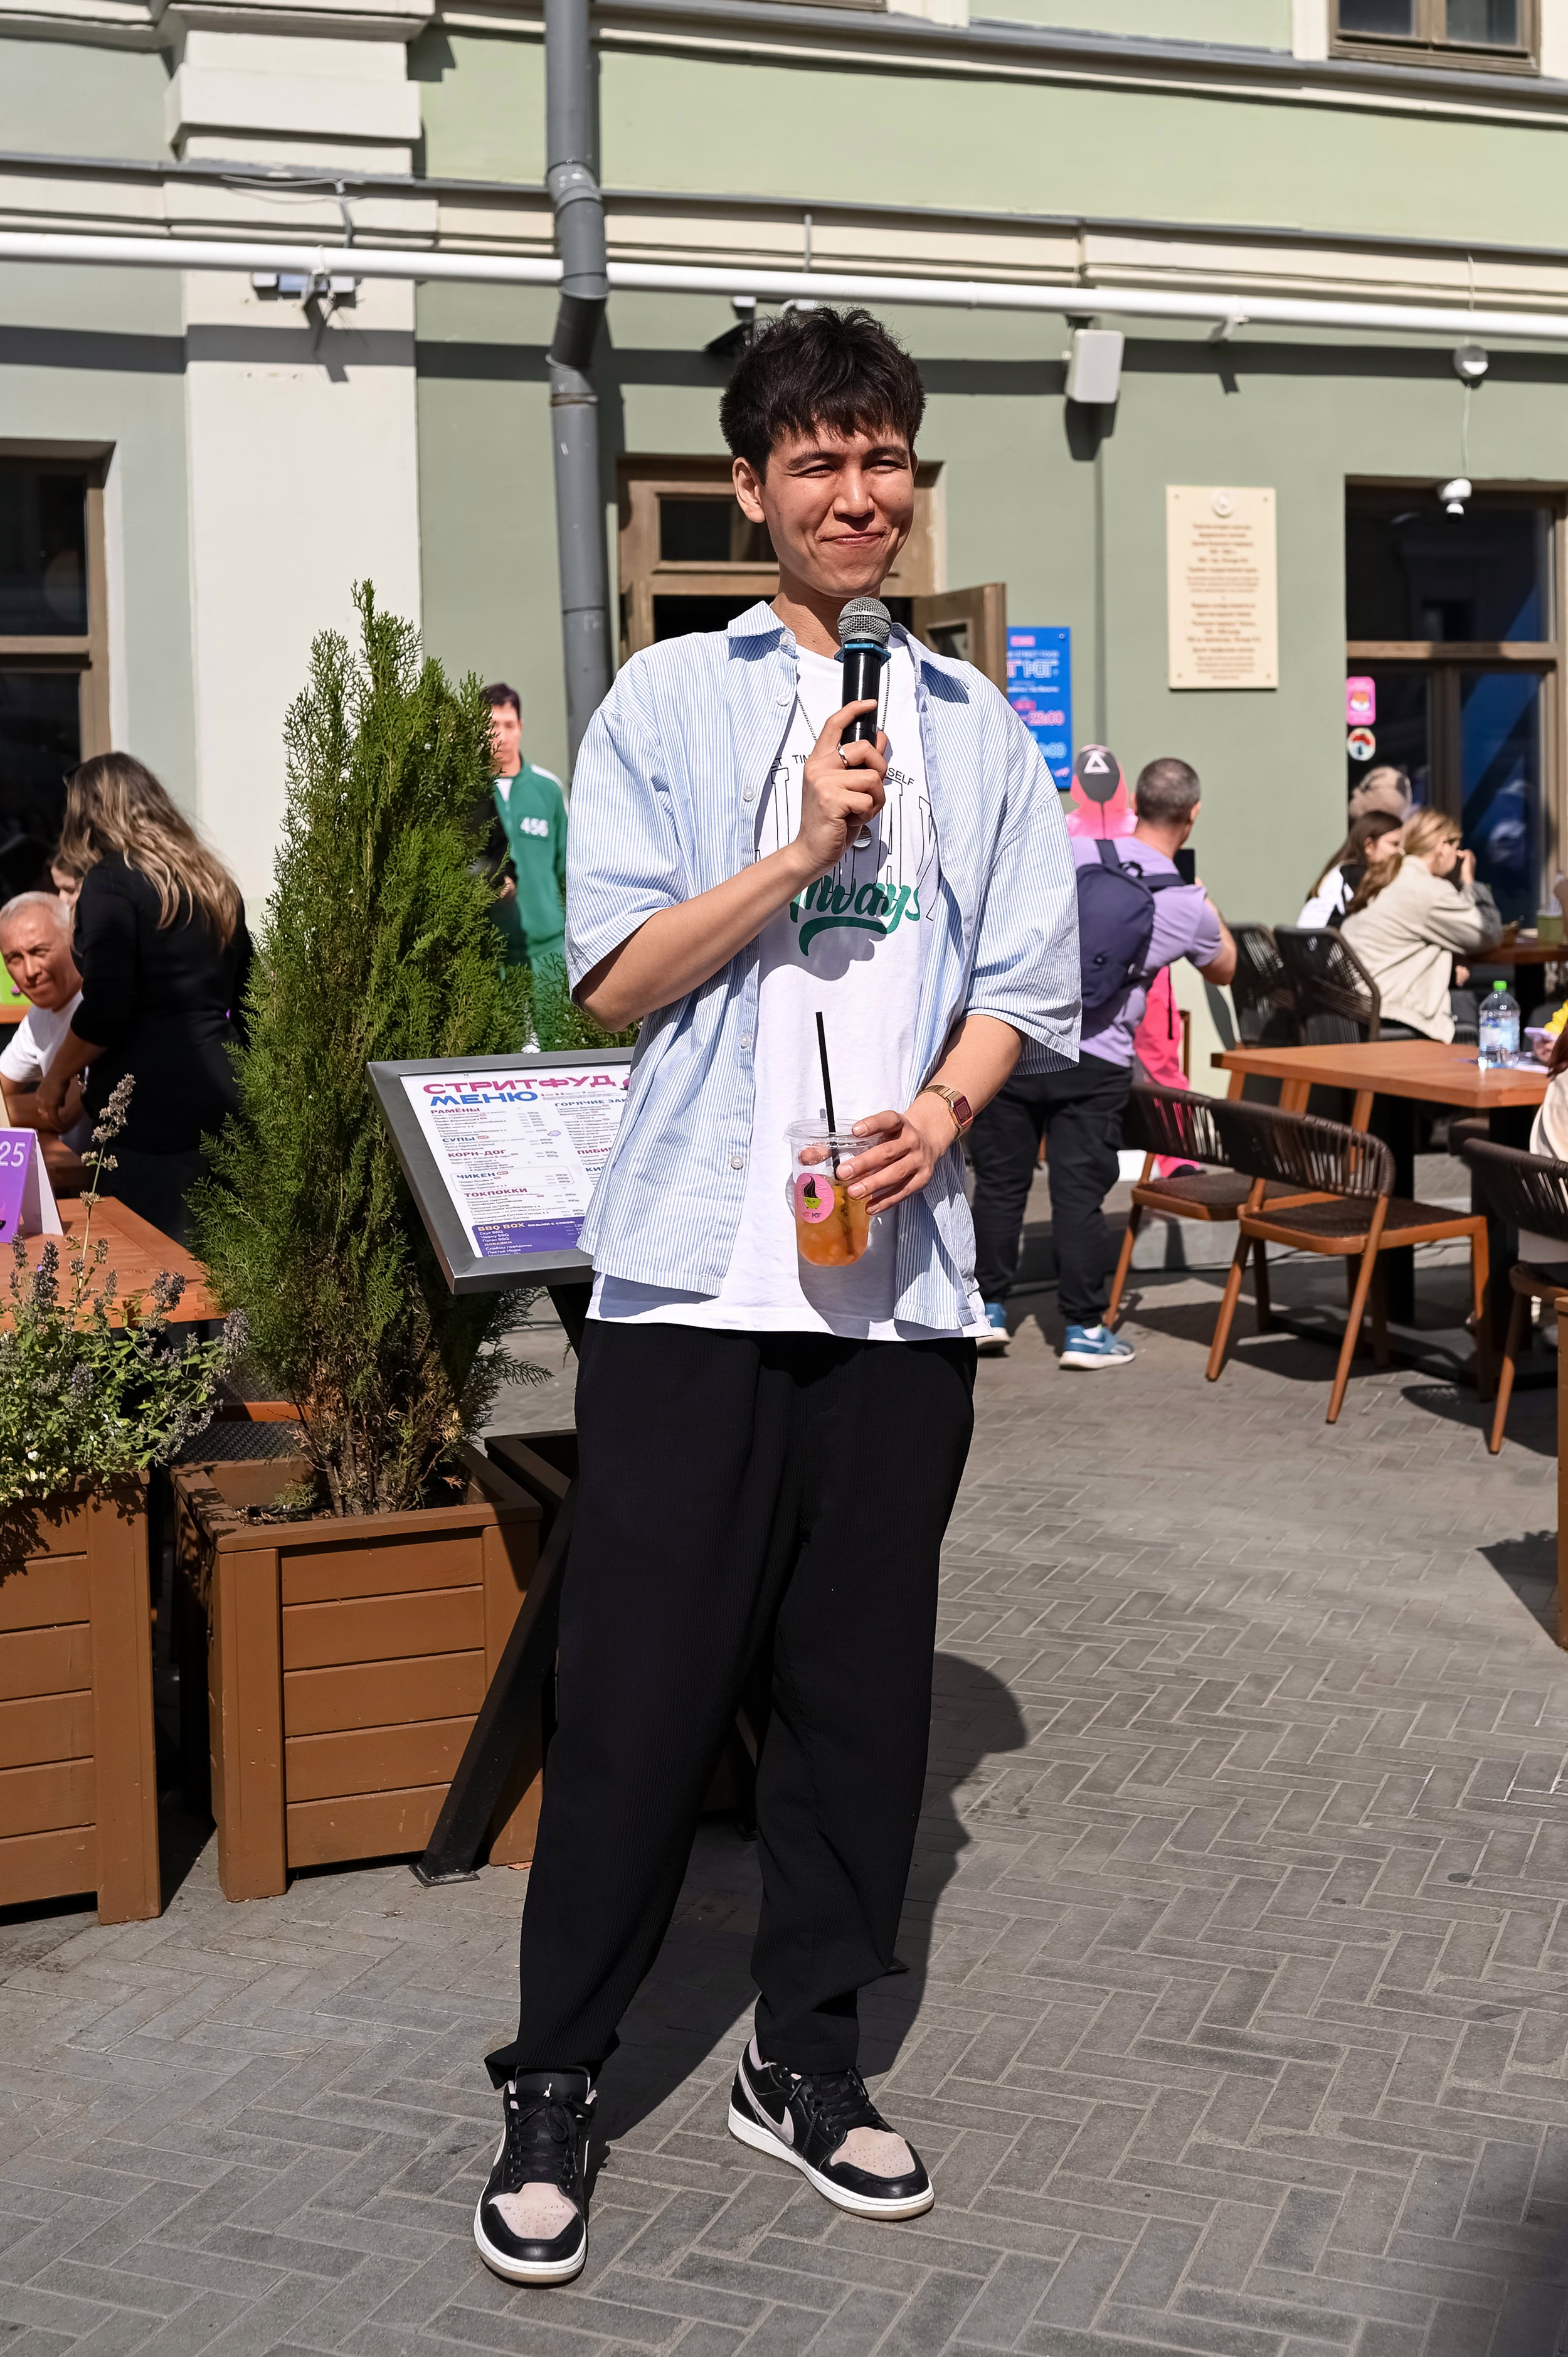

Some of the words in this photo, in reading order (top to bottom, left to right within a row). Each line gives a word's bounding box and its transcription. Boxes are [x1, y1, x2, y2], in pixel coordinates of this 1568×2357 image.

[520, 816, 548, 838] 456
[423, 1075, 617, 1094] СТРИТФУД
[430, 1091, 538, 1106] МЕНЮ
[464, 1188, 527, 1197] ТОКПОККИ
